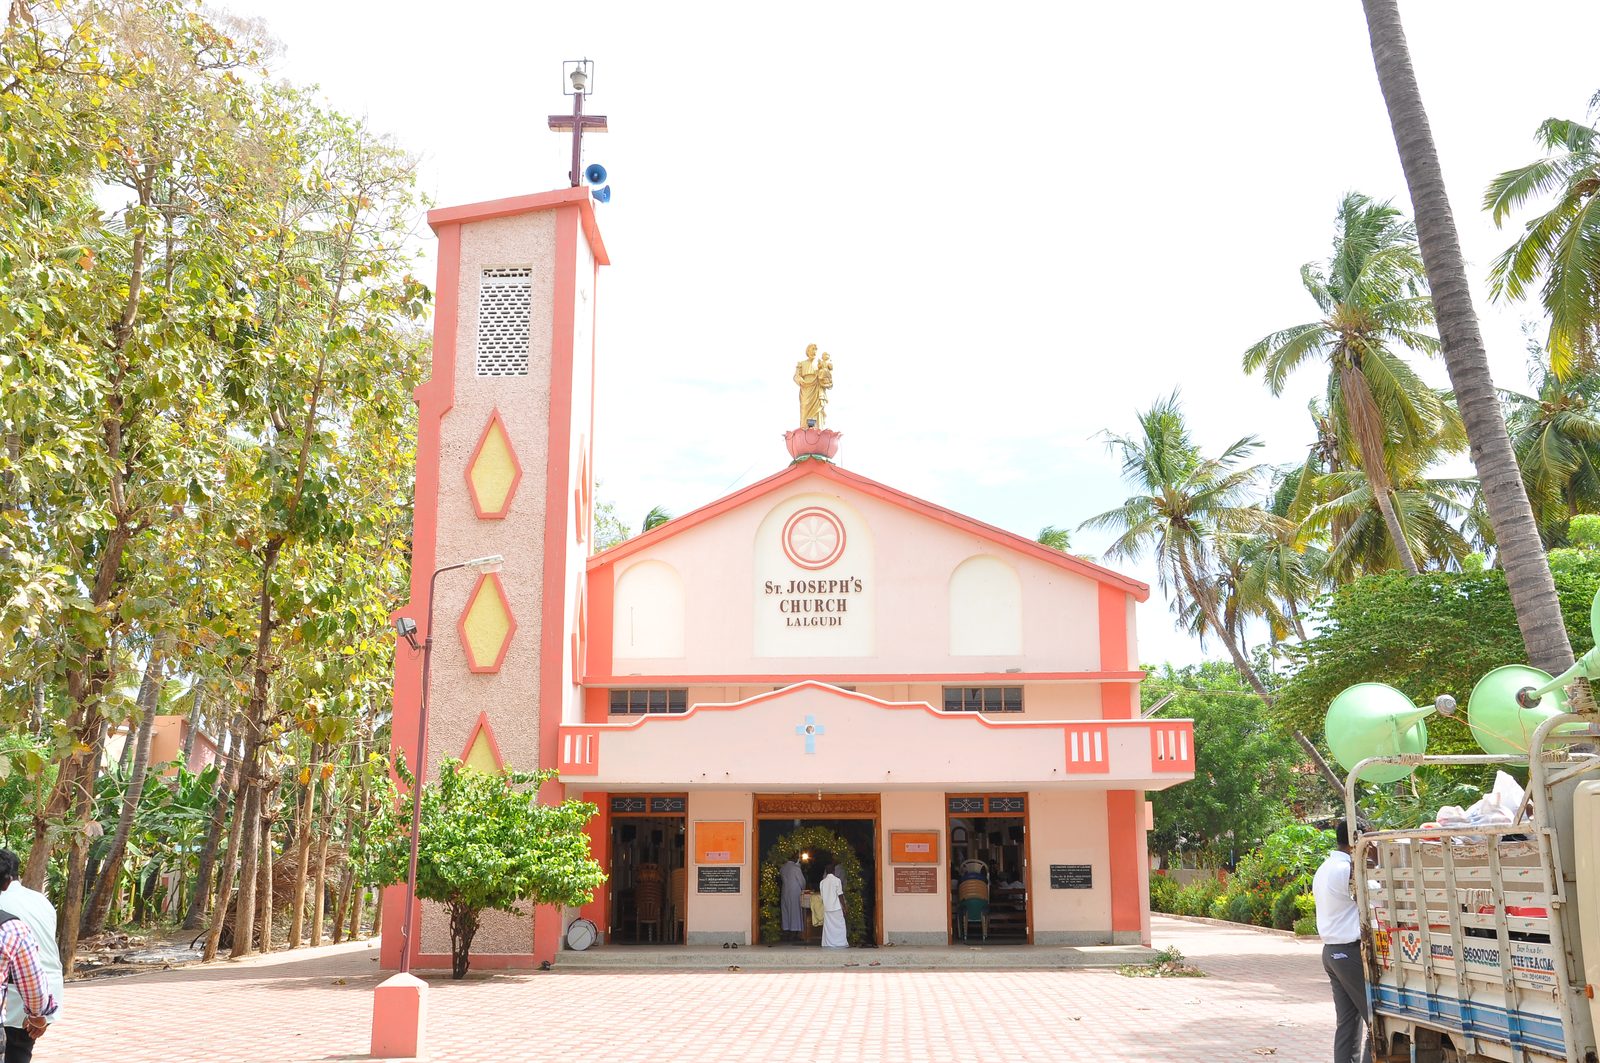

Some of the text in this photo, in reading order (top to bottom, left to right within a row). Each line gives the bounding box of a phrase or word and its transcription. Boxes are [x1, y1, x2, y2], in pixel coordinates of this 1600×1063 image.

[787, 576, 863, 594] JOSEPH'S
[779, 598, 847, 613] CHURCH
[786, 616, 842, 627] LALGUDI
